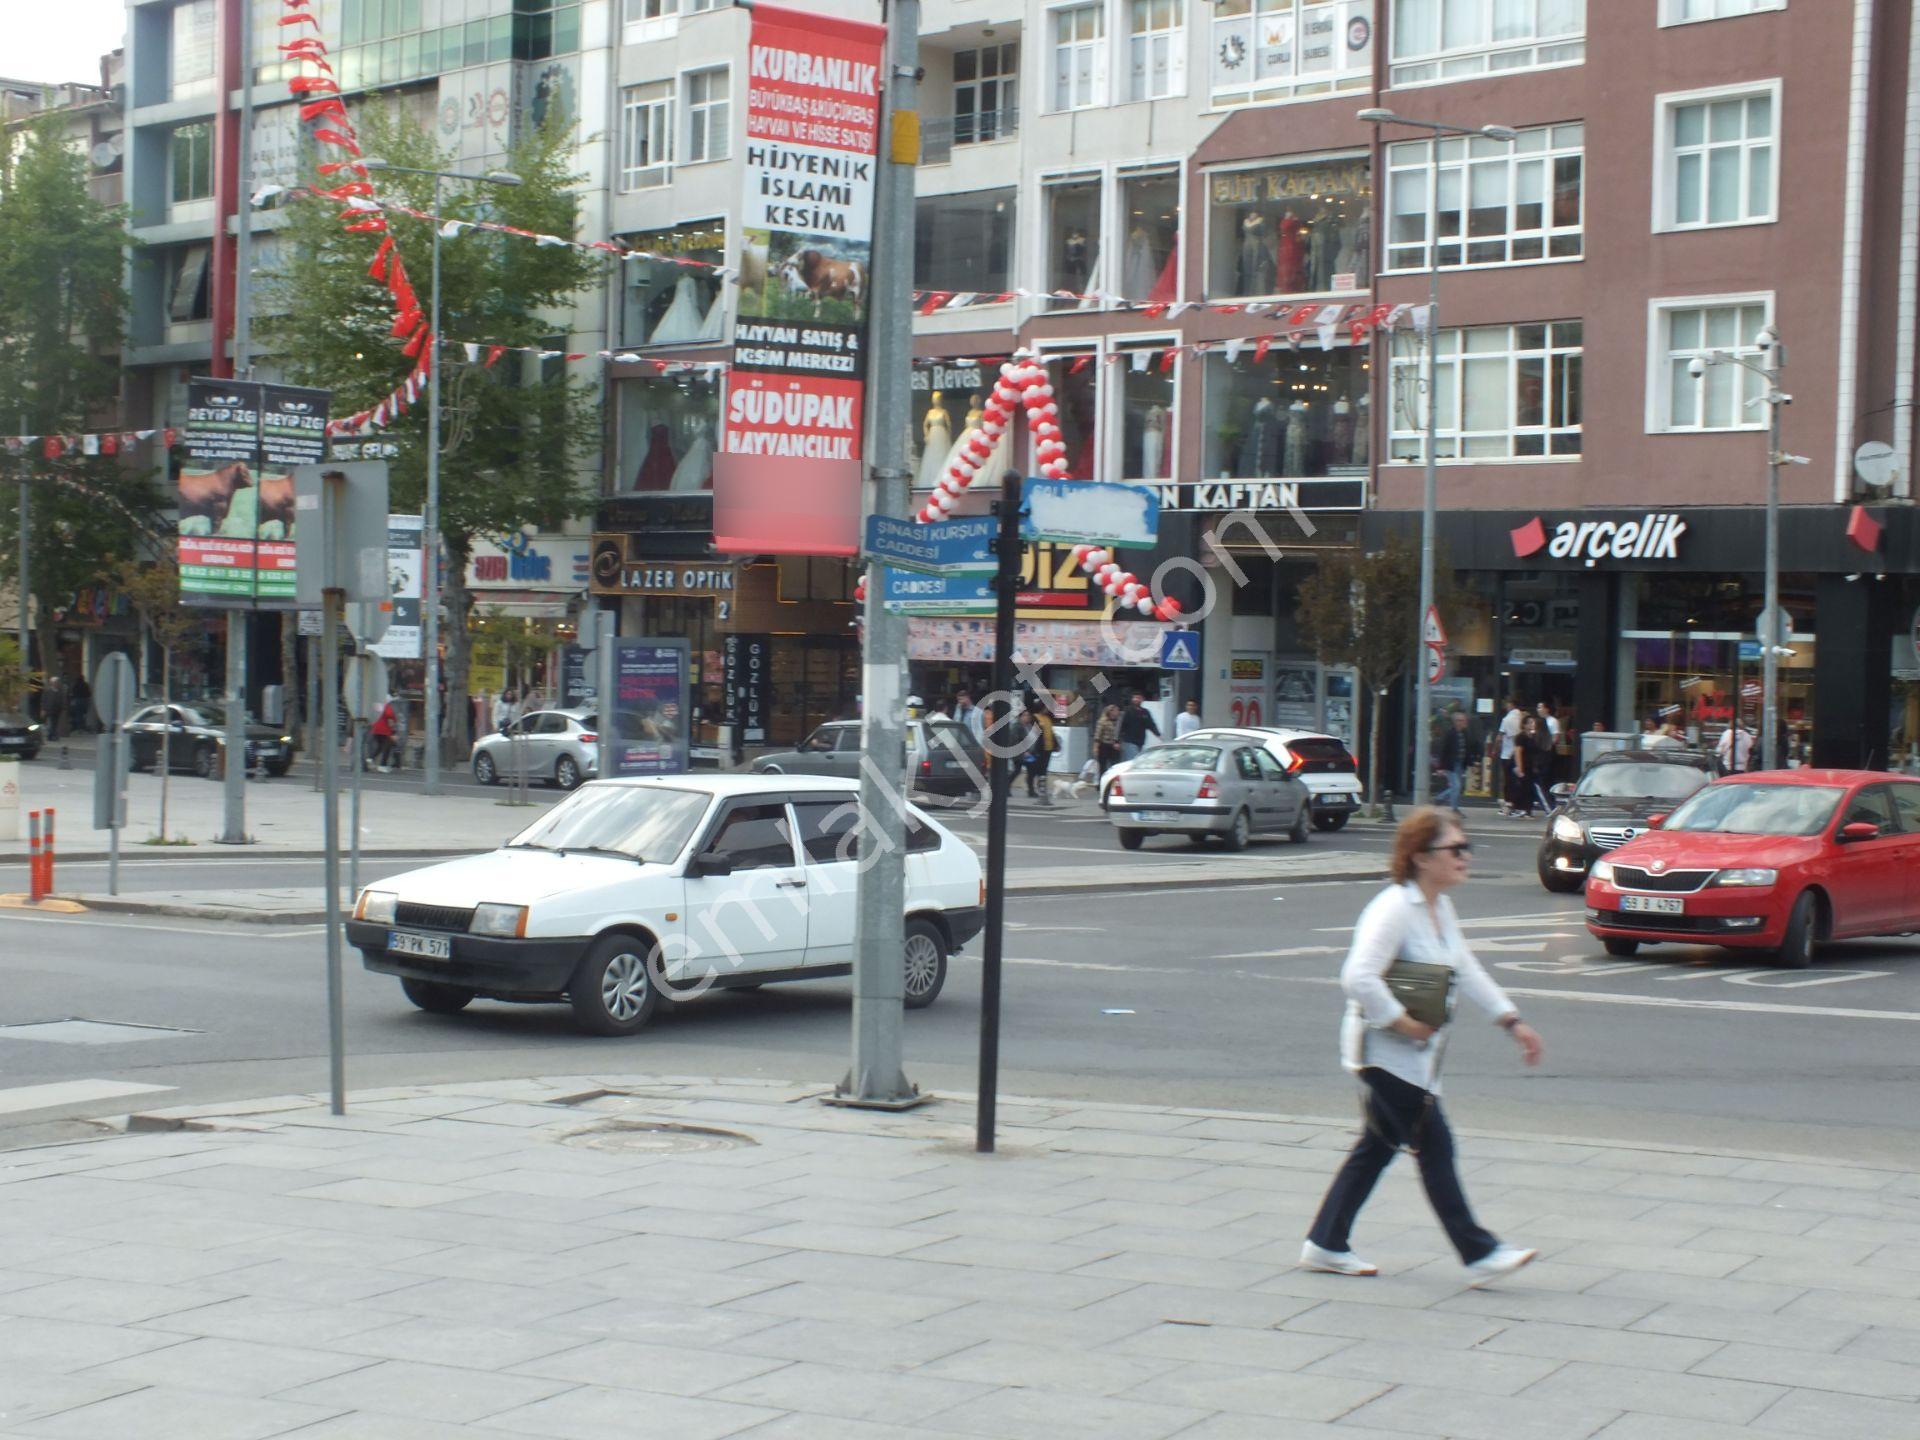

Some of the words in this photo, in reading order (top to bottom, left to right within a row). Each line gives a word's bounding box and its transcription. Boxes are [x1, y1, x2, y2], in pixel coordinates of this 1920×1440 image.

[751, 45, 877, 95] KURBANLIK
[791, 121, 807, 139] VE
[807, 121, 840, 144] HİSSE
[747, 144, 869, 182] HİJYENİK
[760, 171, 851, 206] İSLAMİ
[765, 204, 846, 232] KESİM
[736, 323, 798, 344] HAYVAN
[801, 329, 843, 352] SATIŞ
[846, 334, 858, 349] &
[734, 346, 785, 367] KESİM
[786, 352, 856, 372] MERKEZİ
[729, 379, 854, 430] SÜDÜPAK
[1193, 483, 1299, 508] KAFTAN
[877, 521, 928, 541] ŞİNASİ
[930, 523, 989, 541] KURŞUN
[1549, 514, 1688, 567] arçelik
[875, 538, 940, 560] CADDESİ
[620, 570, 674, 588] LAZER
[683, 570, 732, 590] OPTİK
[718, 602, 730, 620] 2
